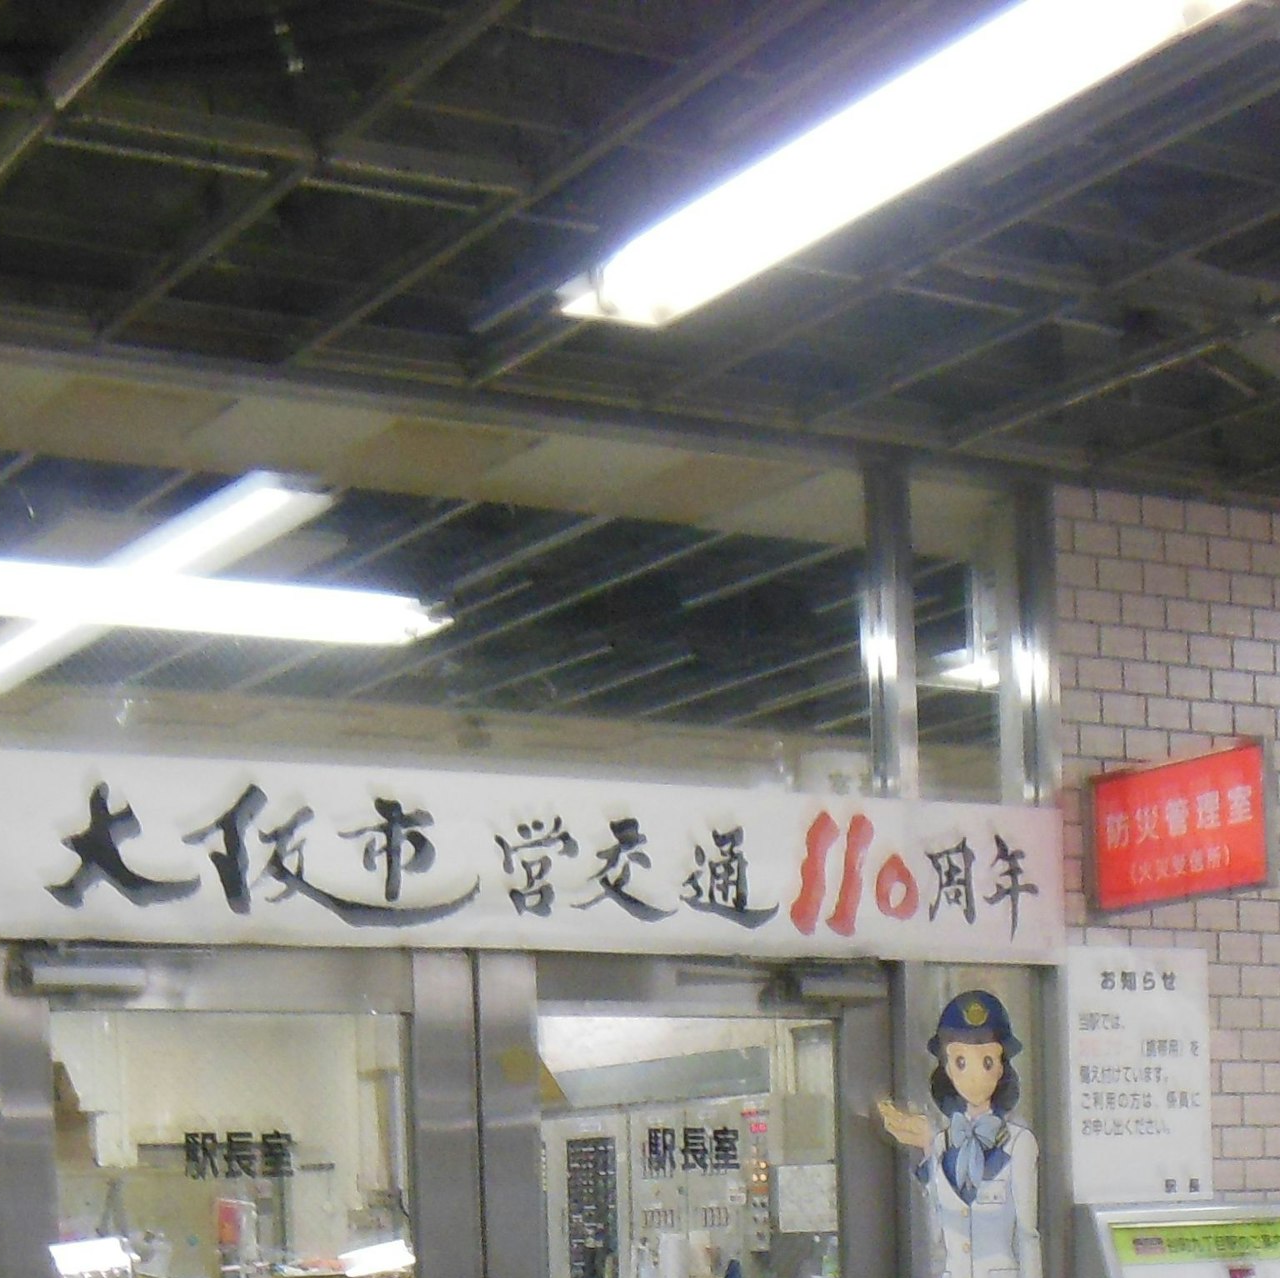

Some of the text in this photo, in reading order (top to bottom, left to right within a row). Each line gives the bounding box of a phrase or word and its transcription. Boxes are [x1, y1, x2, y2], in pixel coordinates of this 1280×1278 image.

[1105, 784, 1254, 851] 防災管理室
[42, 780, 1040, 942] 大阪市営交通110周年
[1101, 971, 1177, 991] お知らせ
[648, 1127, 741, 1171] 駅長室
